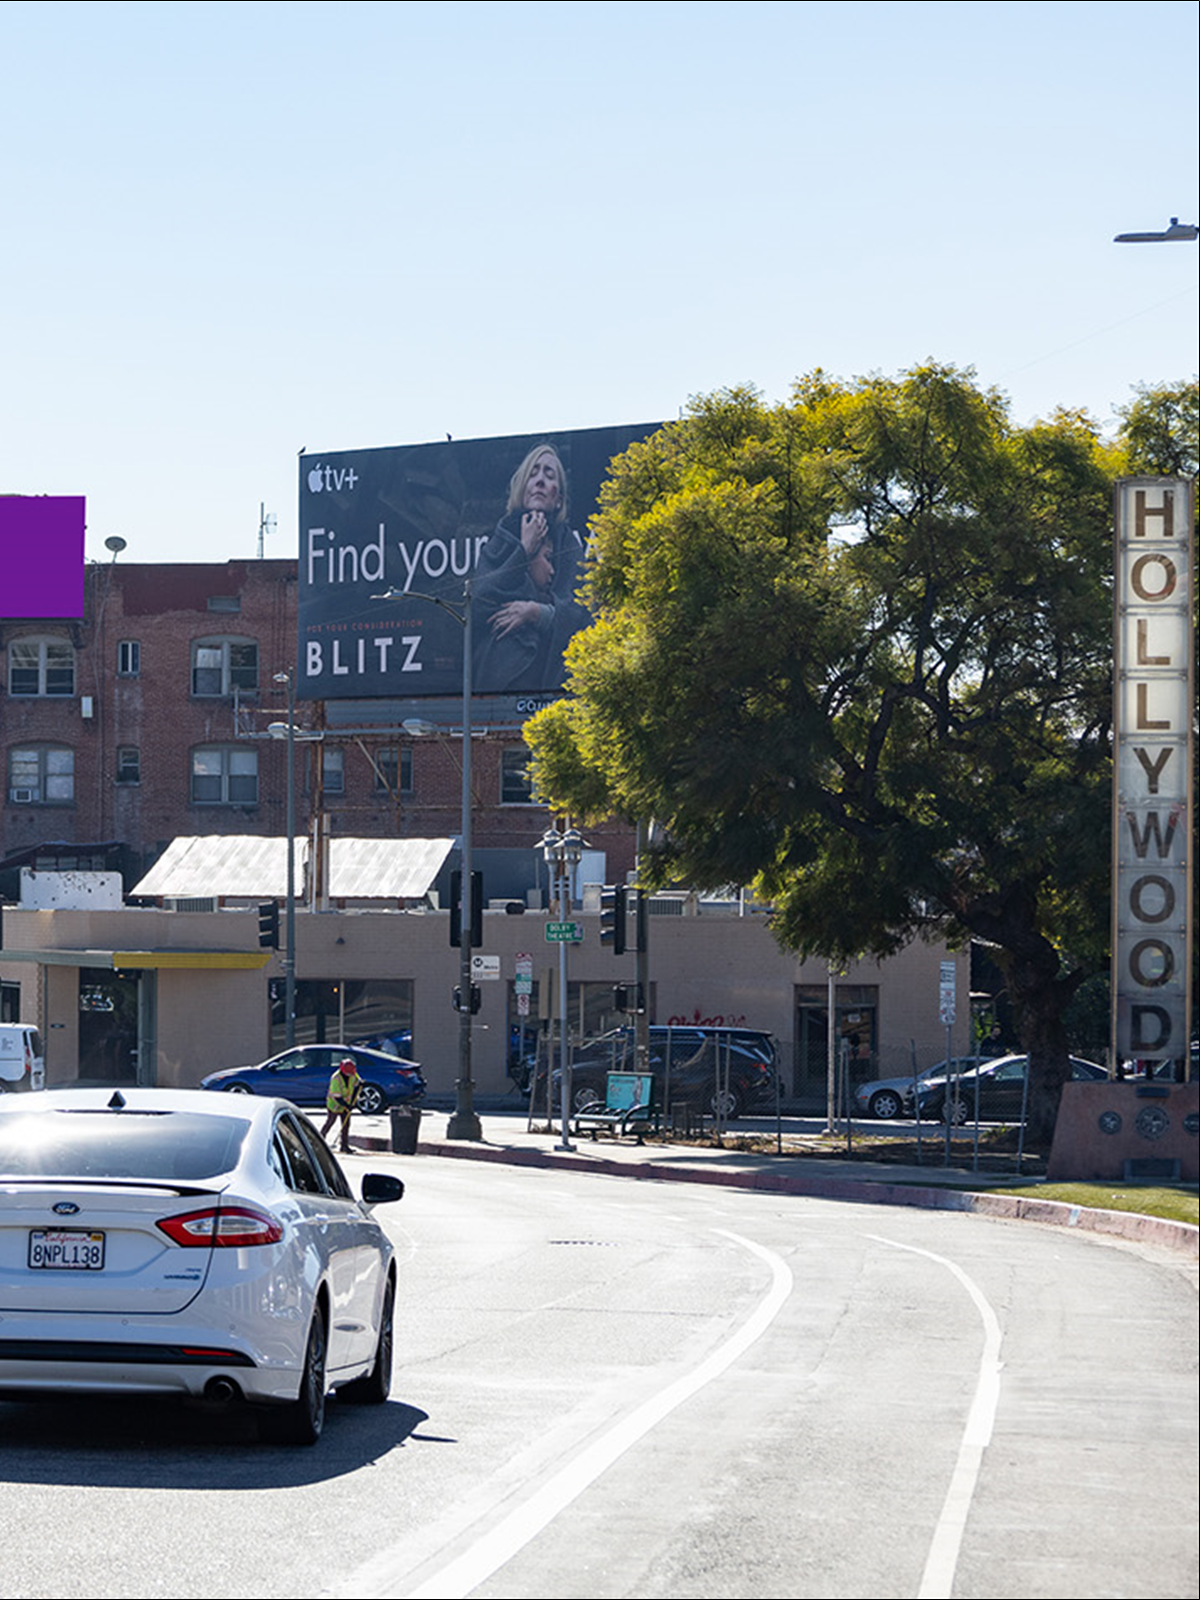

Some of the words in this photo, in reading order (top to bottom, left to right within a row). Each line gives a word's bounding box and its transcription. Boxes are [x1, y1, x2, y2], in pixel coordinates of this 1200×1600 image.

[324, 464, 359, 491] tv+
[308, 523, 385, 584] Find
[398, 535, 489, 592] your
[307, 625, 322, 633] FOR
[326, 624, 348, 632] YOUR
[351, 619, 423, 631] CONSIDERATION
[306, 635, 423, 677] BLITZ
[1126, 490, 1179, 1051] HOLLYWOOD
[45, 1232, 91, 1245] California
[33, 1244, 100, 1264] 8NPL138
